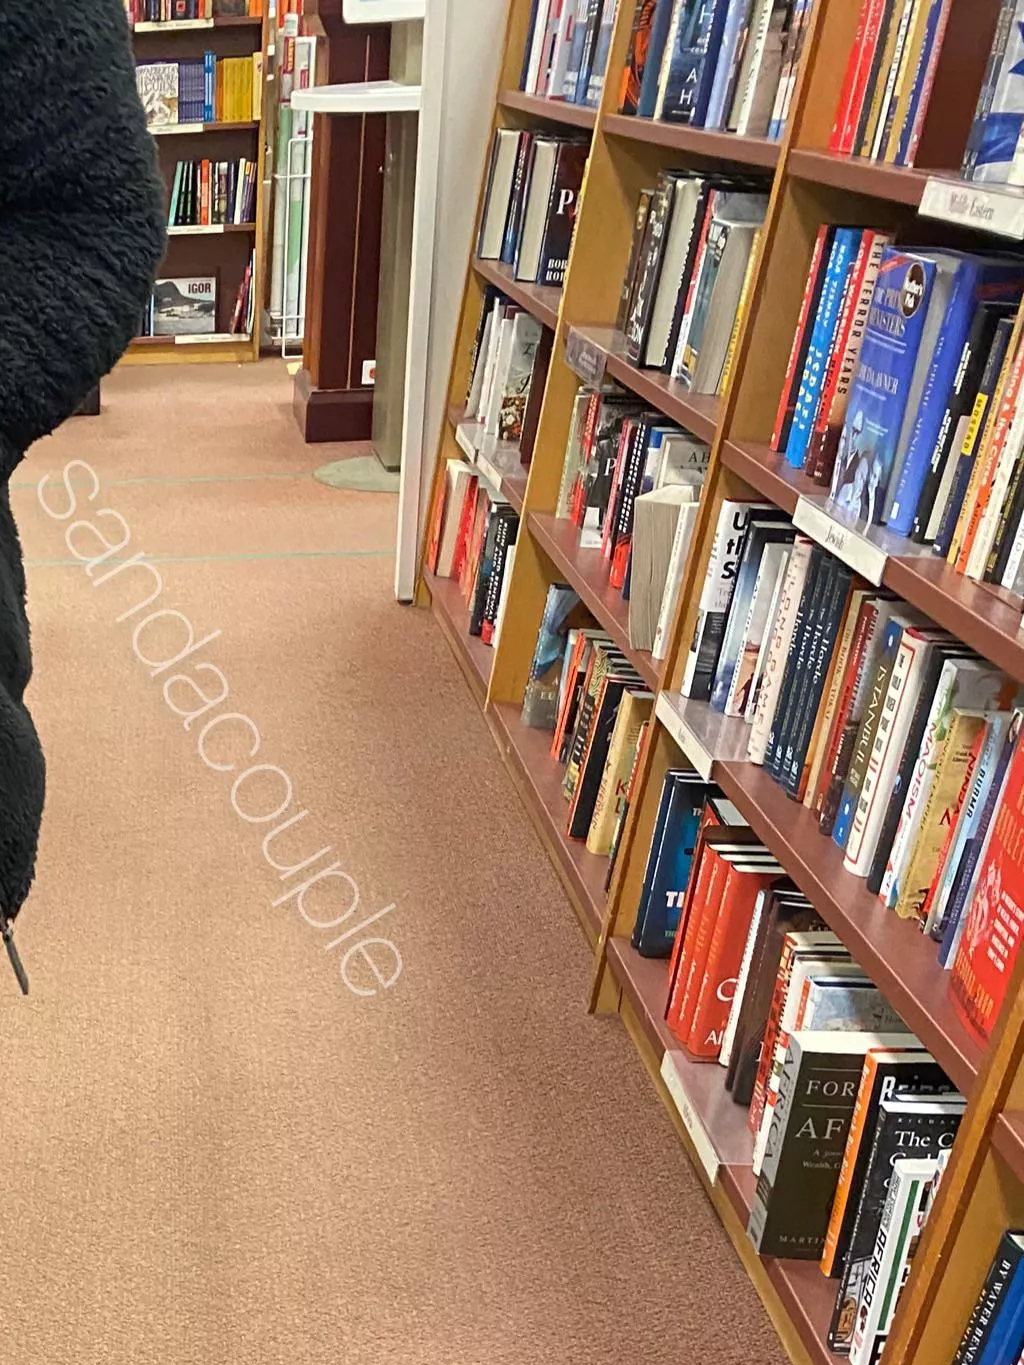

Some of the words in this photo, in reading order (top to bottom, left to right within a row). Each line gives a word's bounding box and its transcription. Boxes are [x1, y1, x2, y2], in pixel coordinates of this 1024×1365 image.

[833, 243, 847, 273] NOA
[868, 240, 884, 270] THE
[188, 283, 211, 294] IGOR
[850, 279, 874, 337] TERROR
[836, 347, 857, 395] YEARS
[788, 612, 803, 656] Horde
[796, 625, 812, 670] Horde
[807, 624, 823, 669] Horde
[812, 638, 829, 684] Horde
[854, 664, 888, 766] ISTANBUL
[905, 722, 936, 820] MAOISM
[964, 767, 986, 819] BURMA
[763, 1048, 798, 1159] AFRICA
[806, 1080, 855, 1097] FOR
[794, 1117, 845, 1140] AF
[894, 1131, 931, 1147] The
[860, 1228, 888, 1308] AFRICA
[996, 1259, 1012, 1279] BY
[978, 1280, 1003, 1325] WATER
